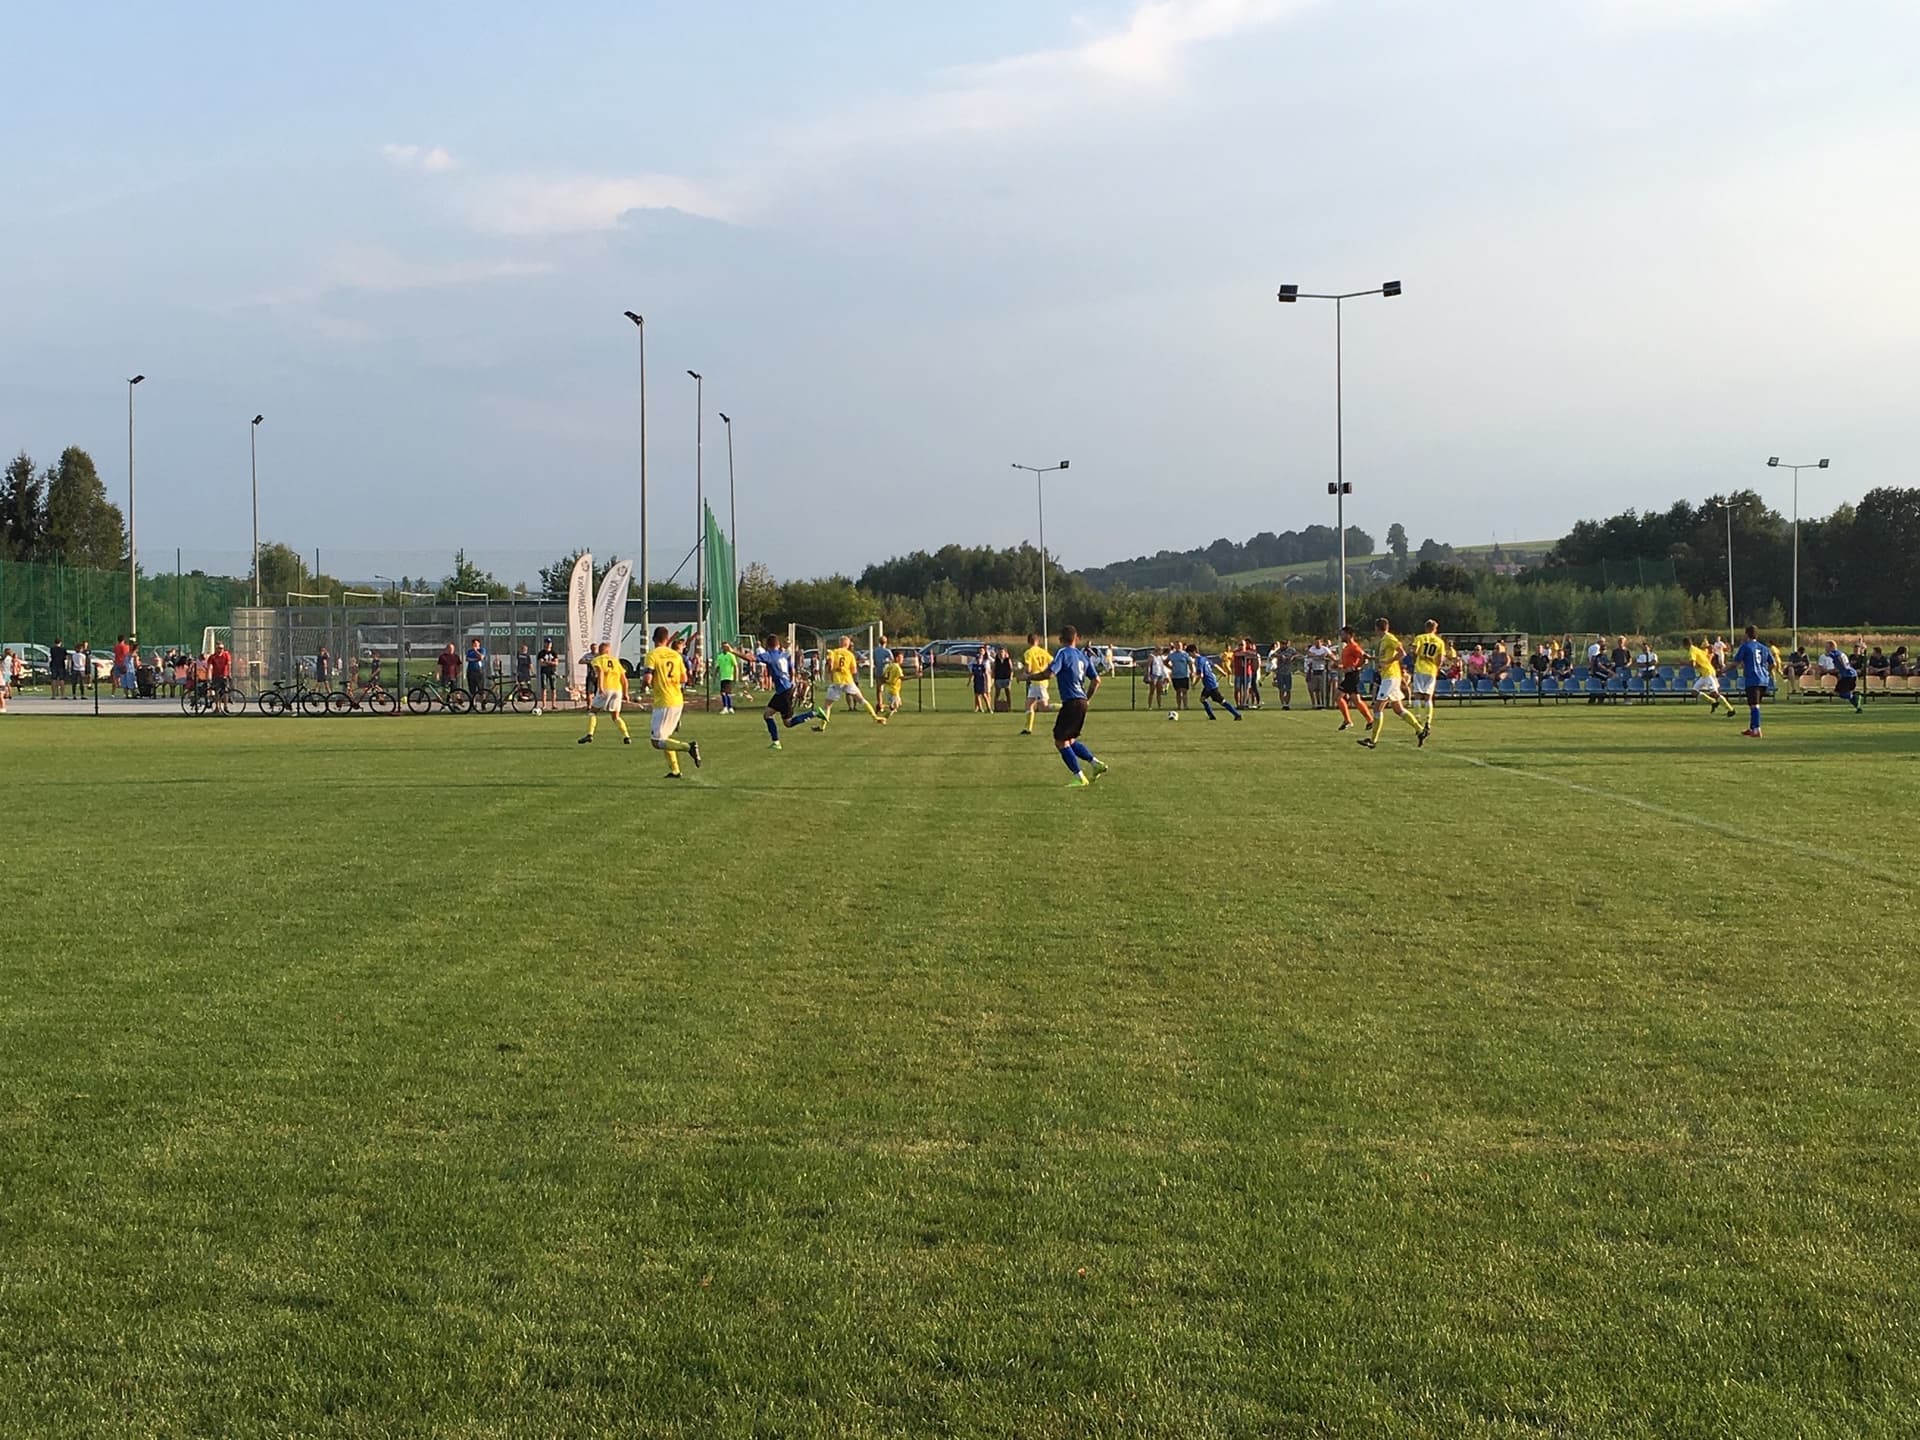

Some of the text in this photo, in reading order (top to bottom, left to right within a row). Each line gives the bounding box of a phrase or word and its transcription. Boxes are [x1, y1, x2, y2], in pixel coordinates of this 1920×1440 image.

[1423, 642, 1438, 657] 10
[1755, 649, 1762, 664] 5
[607, 660, 614, 671] 4
[666, 661, 674, 678] 2
